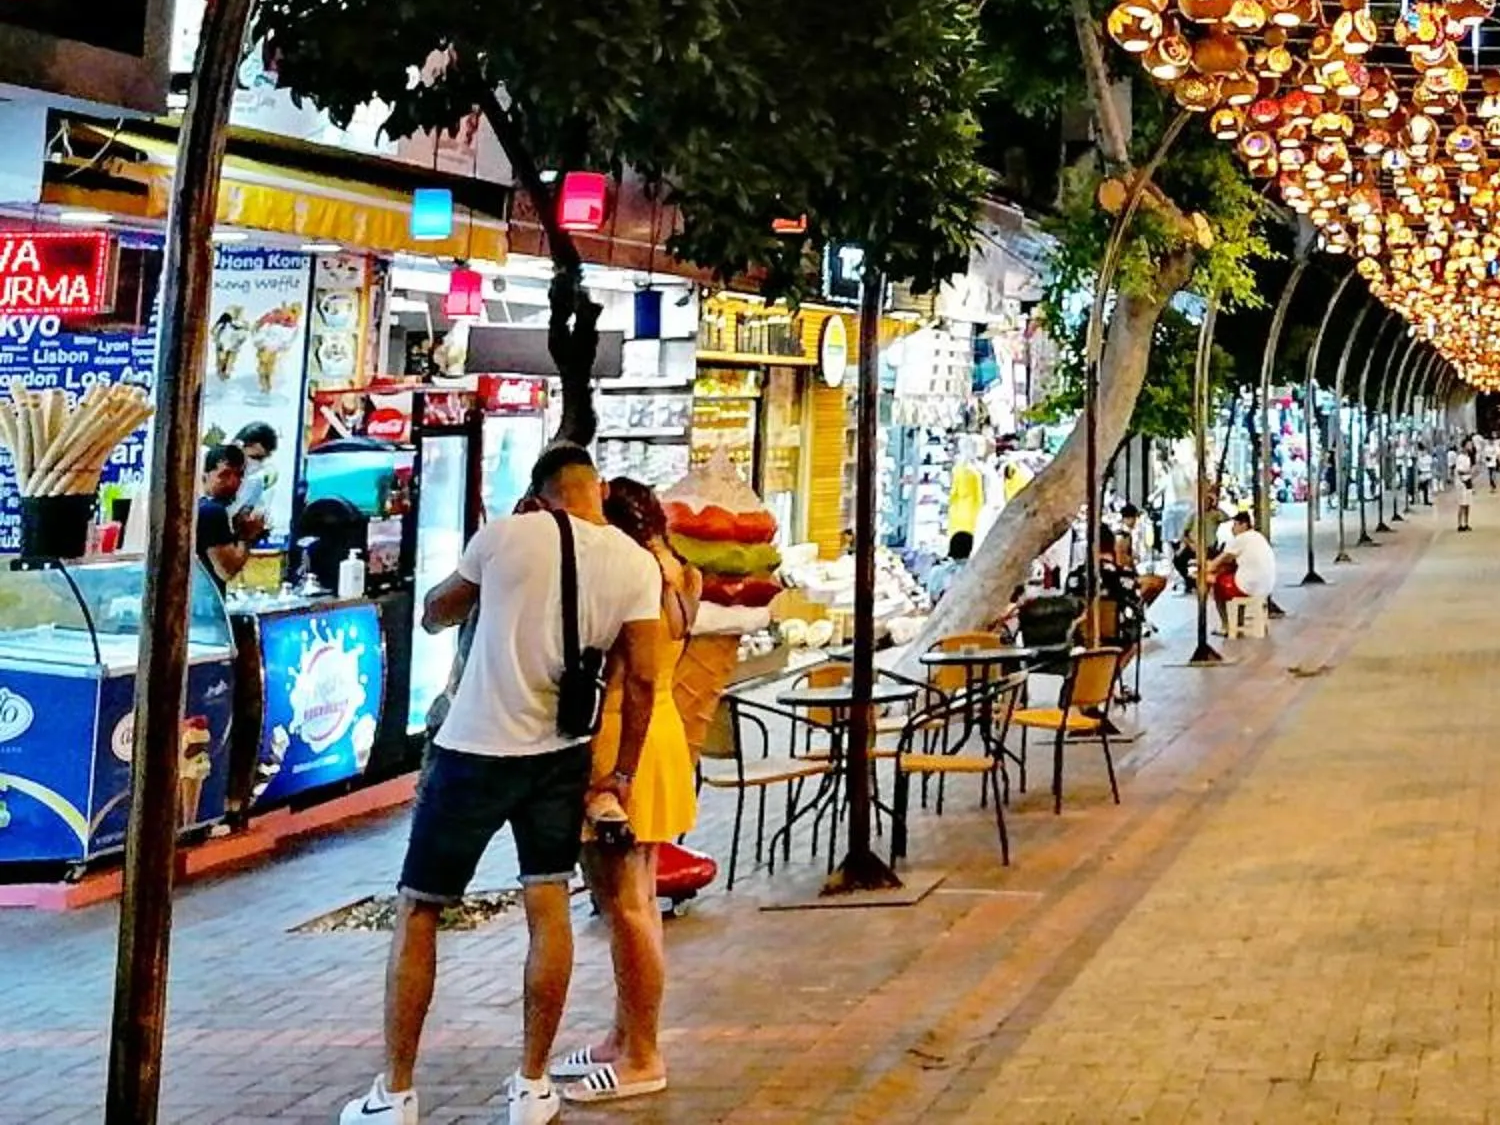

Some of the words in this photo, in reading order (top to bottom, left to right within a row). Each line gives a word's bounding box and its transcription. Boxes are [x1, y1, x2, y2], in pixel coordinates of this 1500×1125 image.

[221, 256, 264, 271] Hong
[98, 339, 129, 354] Lyon
[33, 349, 89, 364] Lisbon
[65, 367, 111, 389] Los
